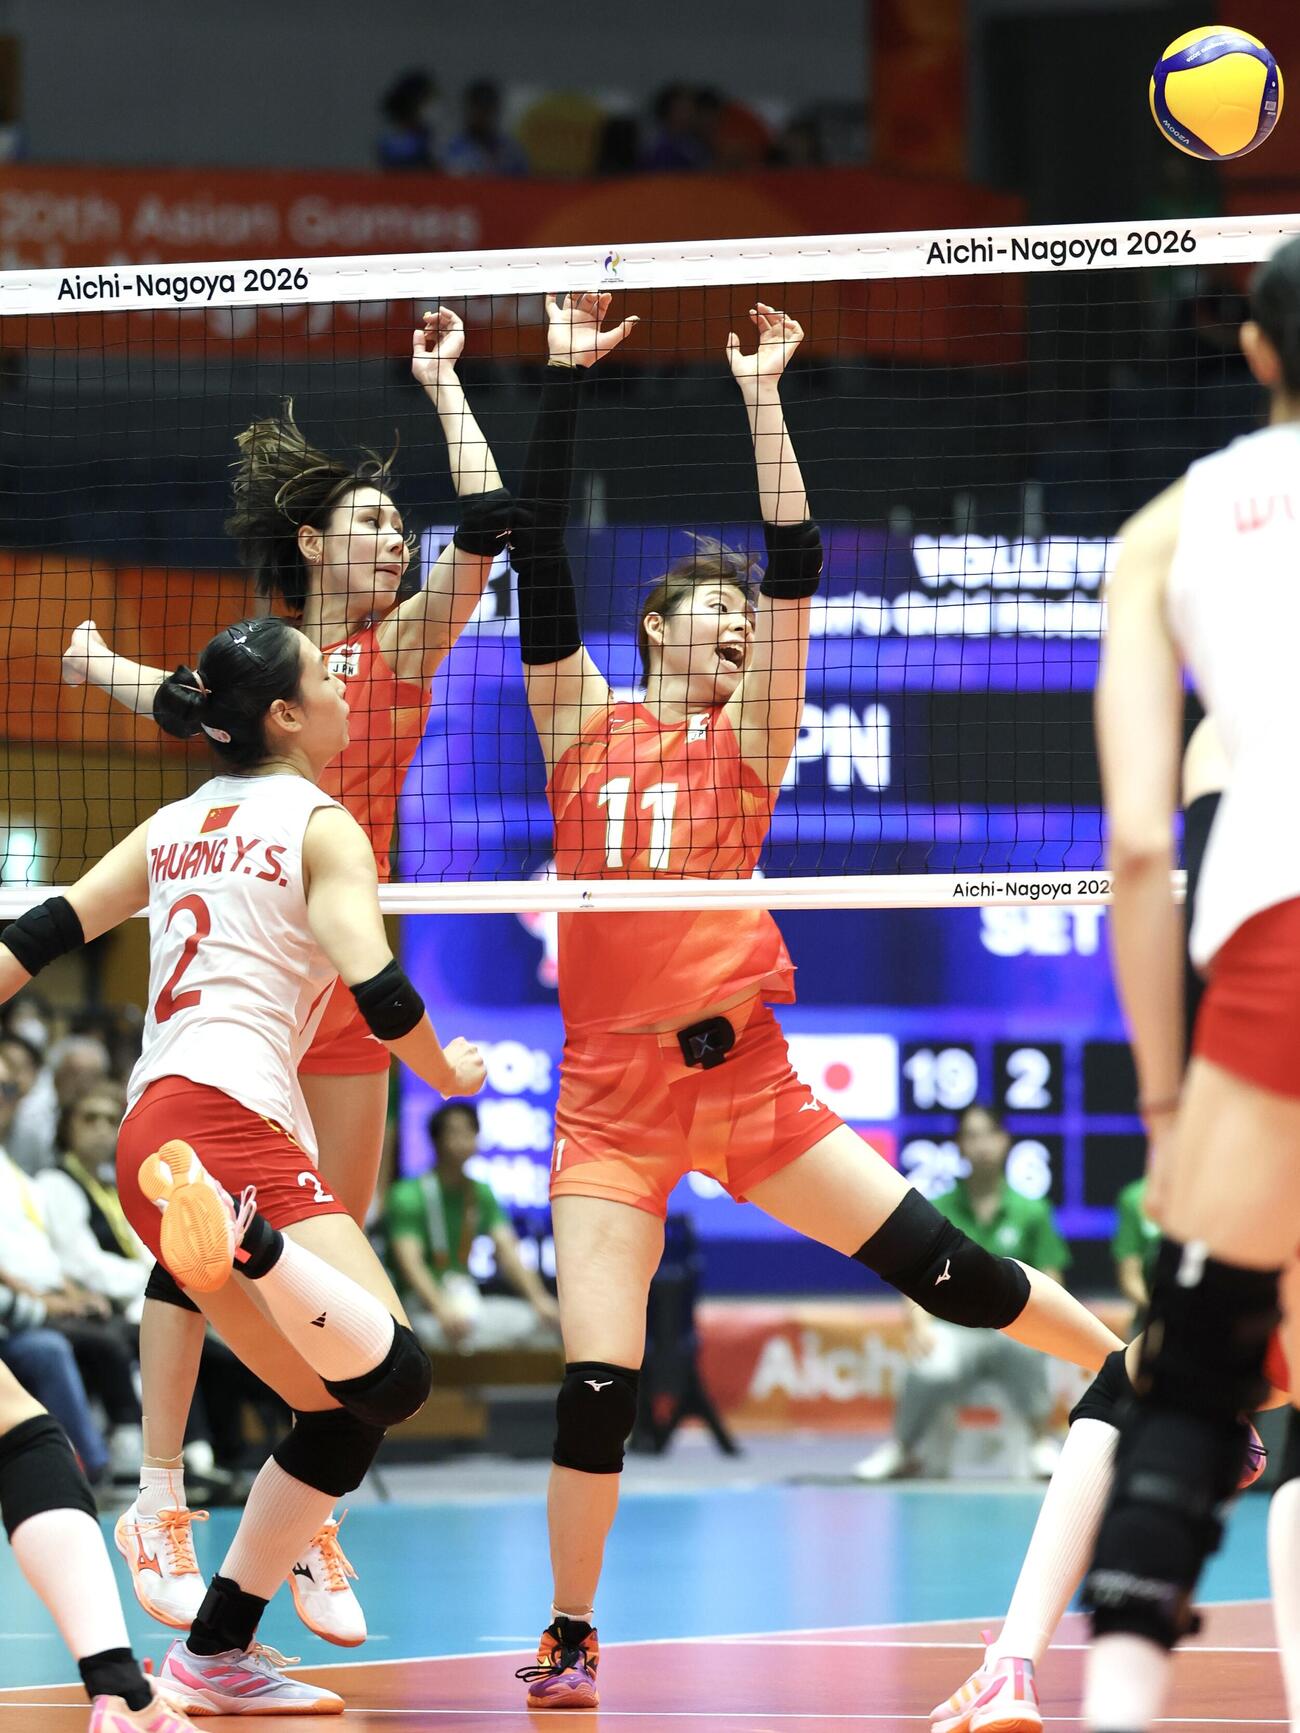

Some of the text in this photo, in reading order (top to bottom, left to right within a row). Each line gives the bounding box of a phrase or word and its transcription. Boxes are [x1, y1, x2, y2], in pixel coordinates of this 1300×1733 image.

[1162, 120, 1190, 145] V200W
[927, 229, 1197, 267] Aichi-Nagoya 2026
[57, 267, 309, 302] Aichi-Nagoya 2026
[332, 664, 354, 675] JPN
[781, 703, 891, 793] PN
[597, 777, 679, 869] 11
[230, 835, 288, 888] Y.S.
[952, 880, 1116, 901] Aichi-Nagoya 202
[154, 893, 211, 1025] 2
[903, 1047, 978, 1110] 19
[1005, 1047, 1051, 1110] 2
[297, 1171, 335, 1203] 2
[1005, 1139, 1052, 1200] 6
